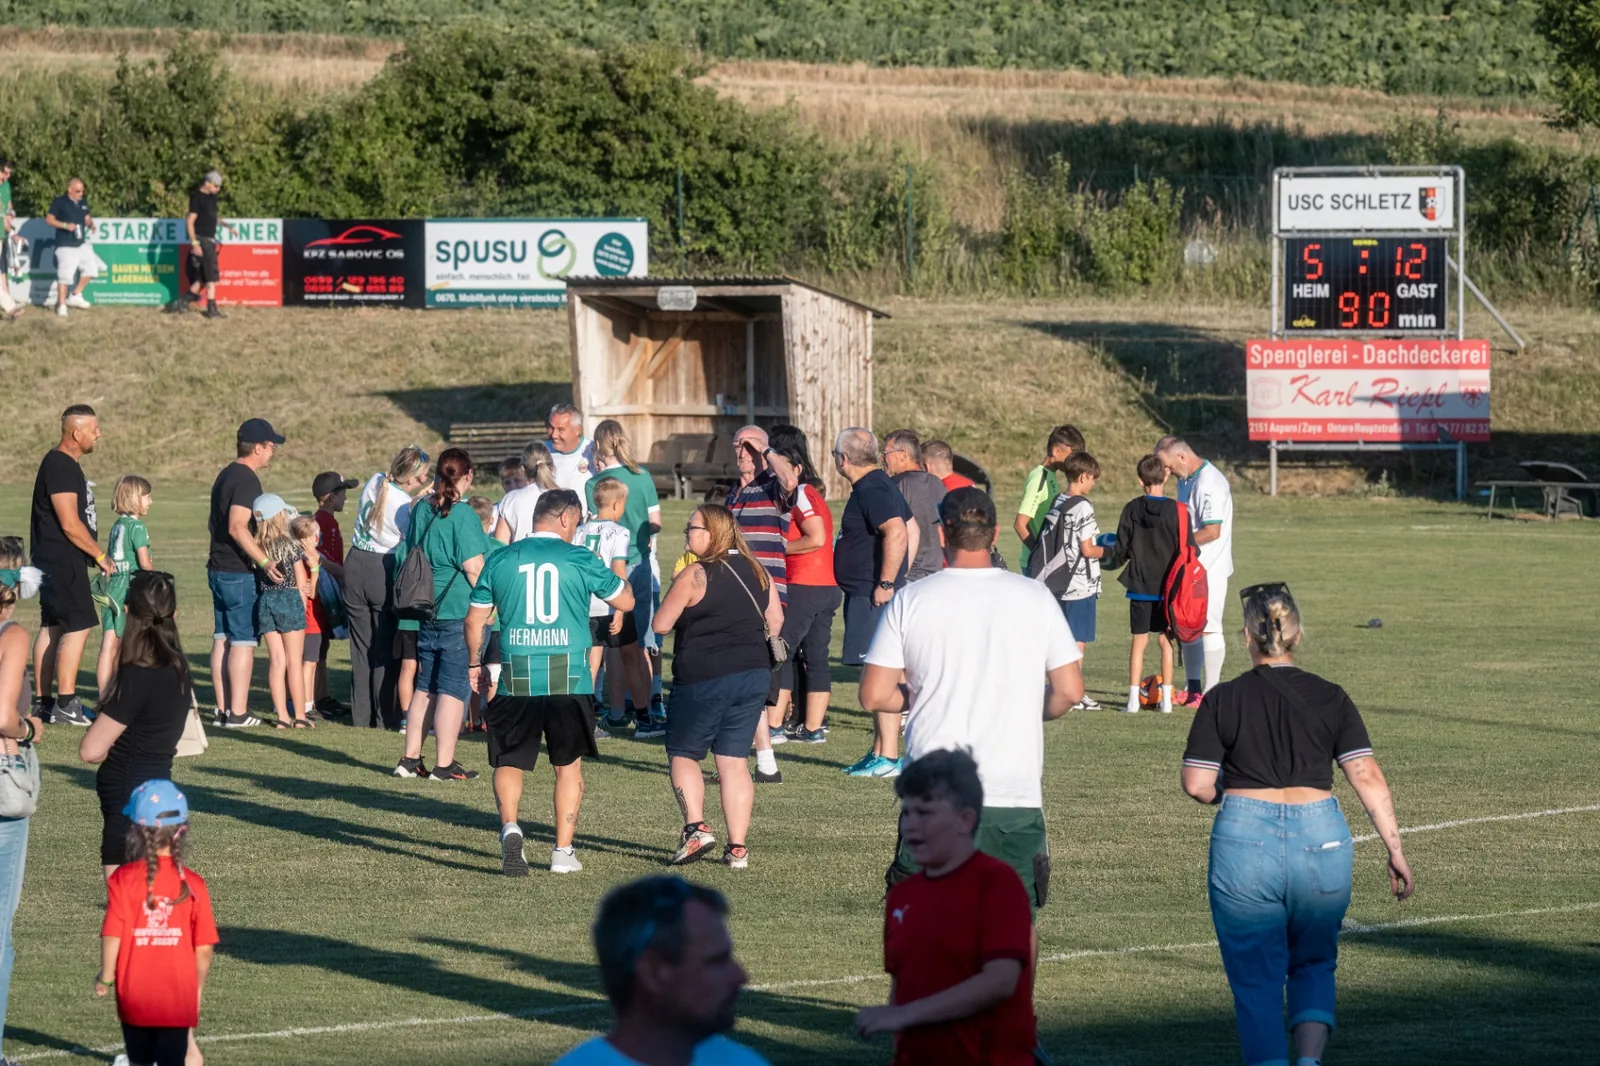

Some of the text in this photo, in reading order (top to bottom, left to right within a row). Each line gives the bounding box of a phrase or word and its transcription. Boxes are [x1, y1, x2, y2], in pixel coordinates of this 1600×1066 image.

[1288, 193, 1412, 211] USC SCHLETZ
[100, 222, 177, 241] STARKE
[435, 239, 527, 271] spusu
[1303, 244, 1324, 280] 5
[1395, 243, 1427, 280] 12
[1292, 284, 1438, 299] HEIM GAST
[1338, 292, 1390, 328] 90
[1398, 312, 1437, 328] min
[1250, 344, 1348, 368] Spenglerei
[1363, 343, 1487, 365] Dachdeckerei
[1289, 374, 1448, 415] Karl Riepl
[519, 562, 560, 625] 10
[509, 628, 569, 646] HERMANN
